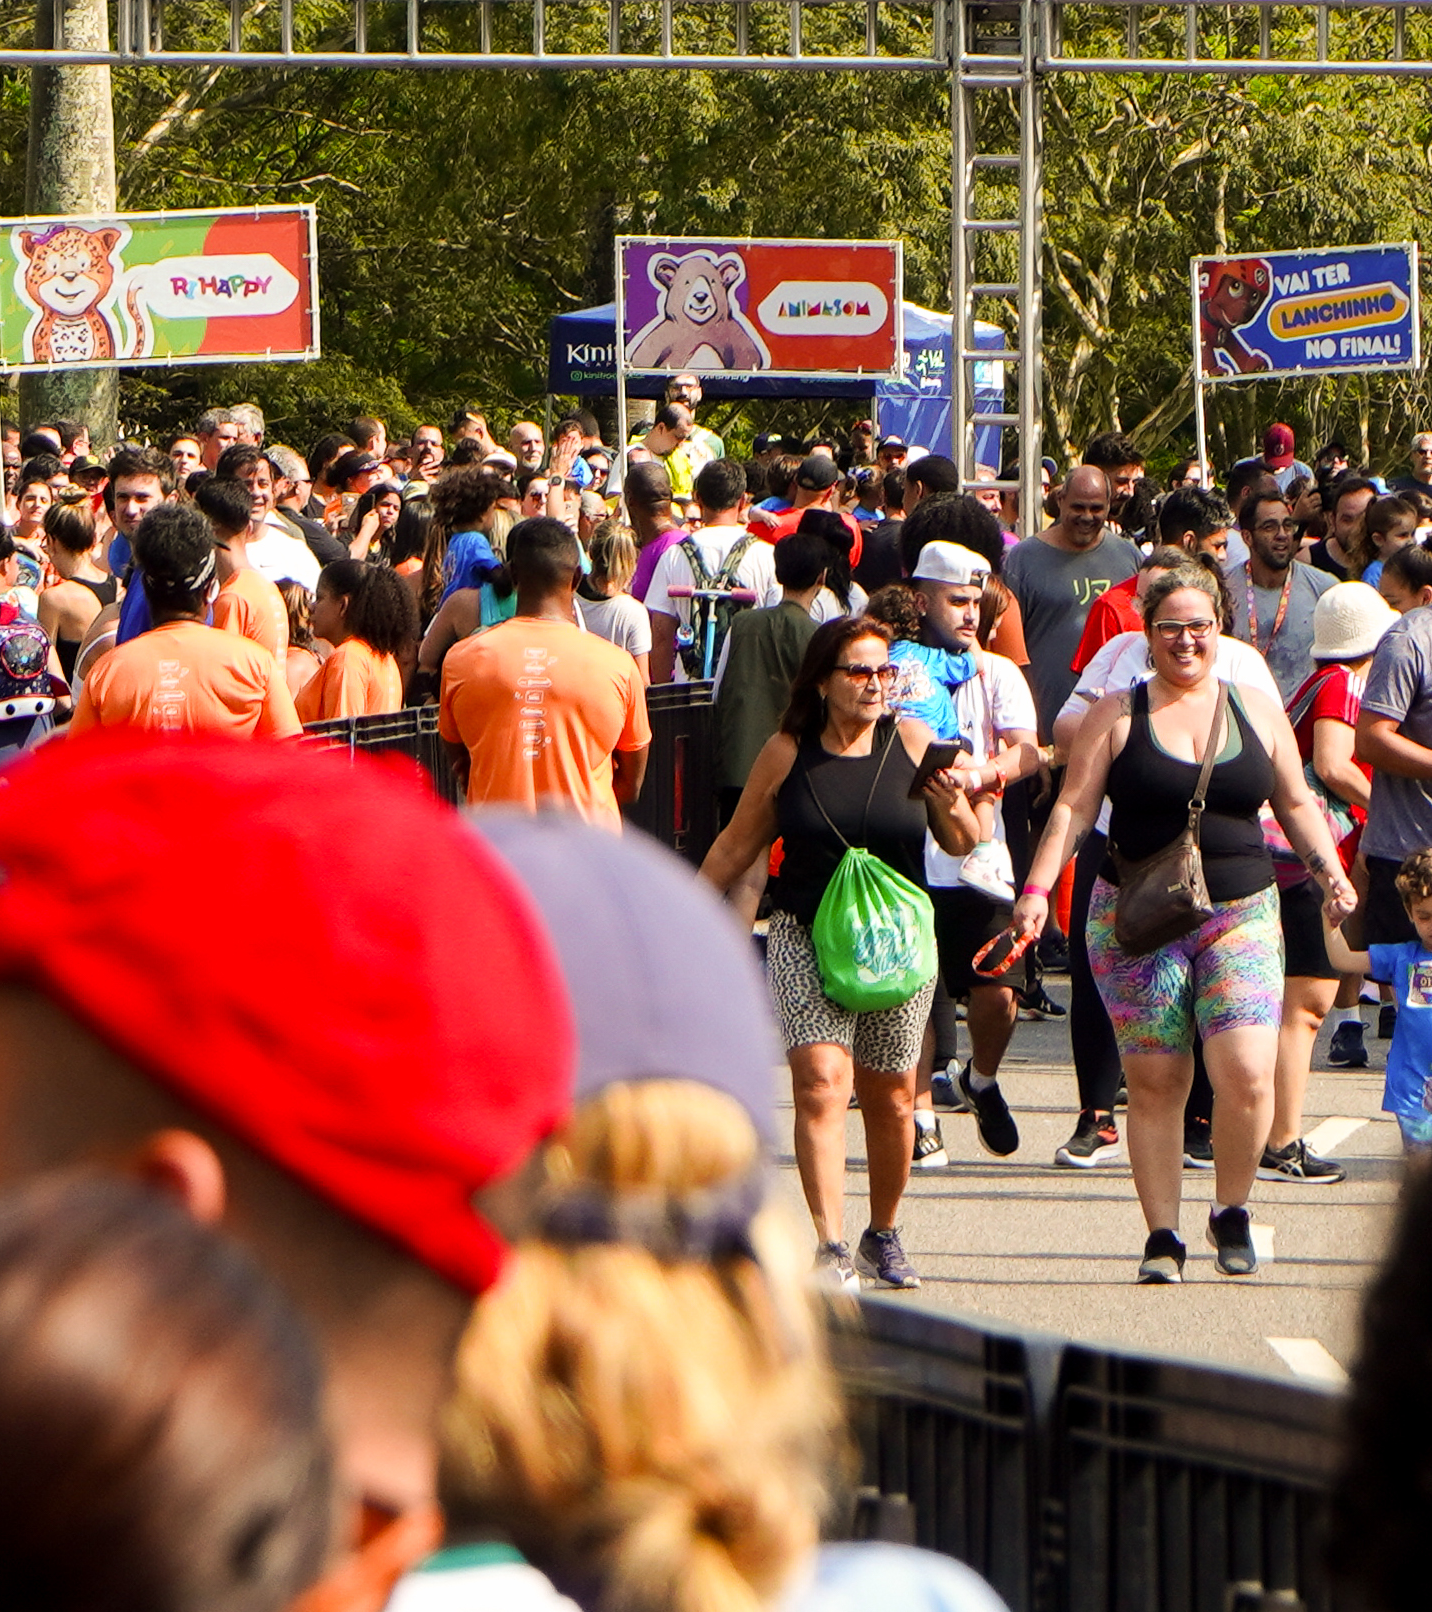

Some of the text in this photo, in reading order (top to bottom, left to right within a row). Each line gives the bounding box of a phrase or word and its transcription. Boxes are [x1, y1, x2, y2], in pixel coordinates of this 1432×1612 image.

[1274, 261, 1351, 297] VAI TER
[777, 298, 871, 318] ANIMASOM
[1280, 292, 1397, 331] LANCHINHO
[1305, 333, 1401, 359] NO FINAL!
